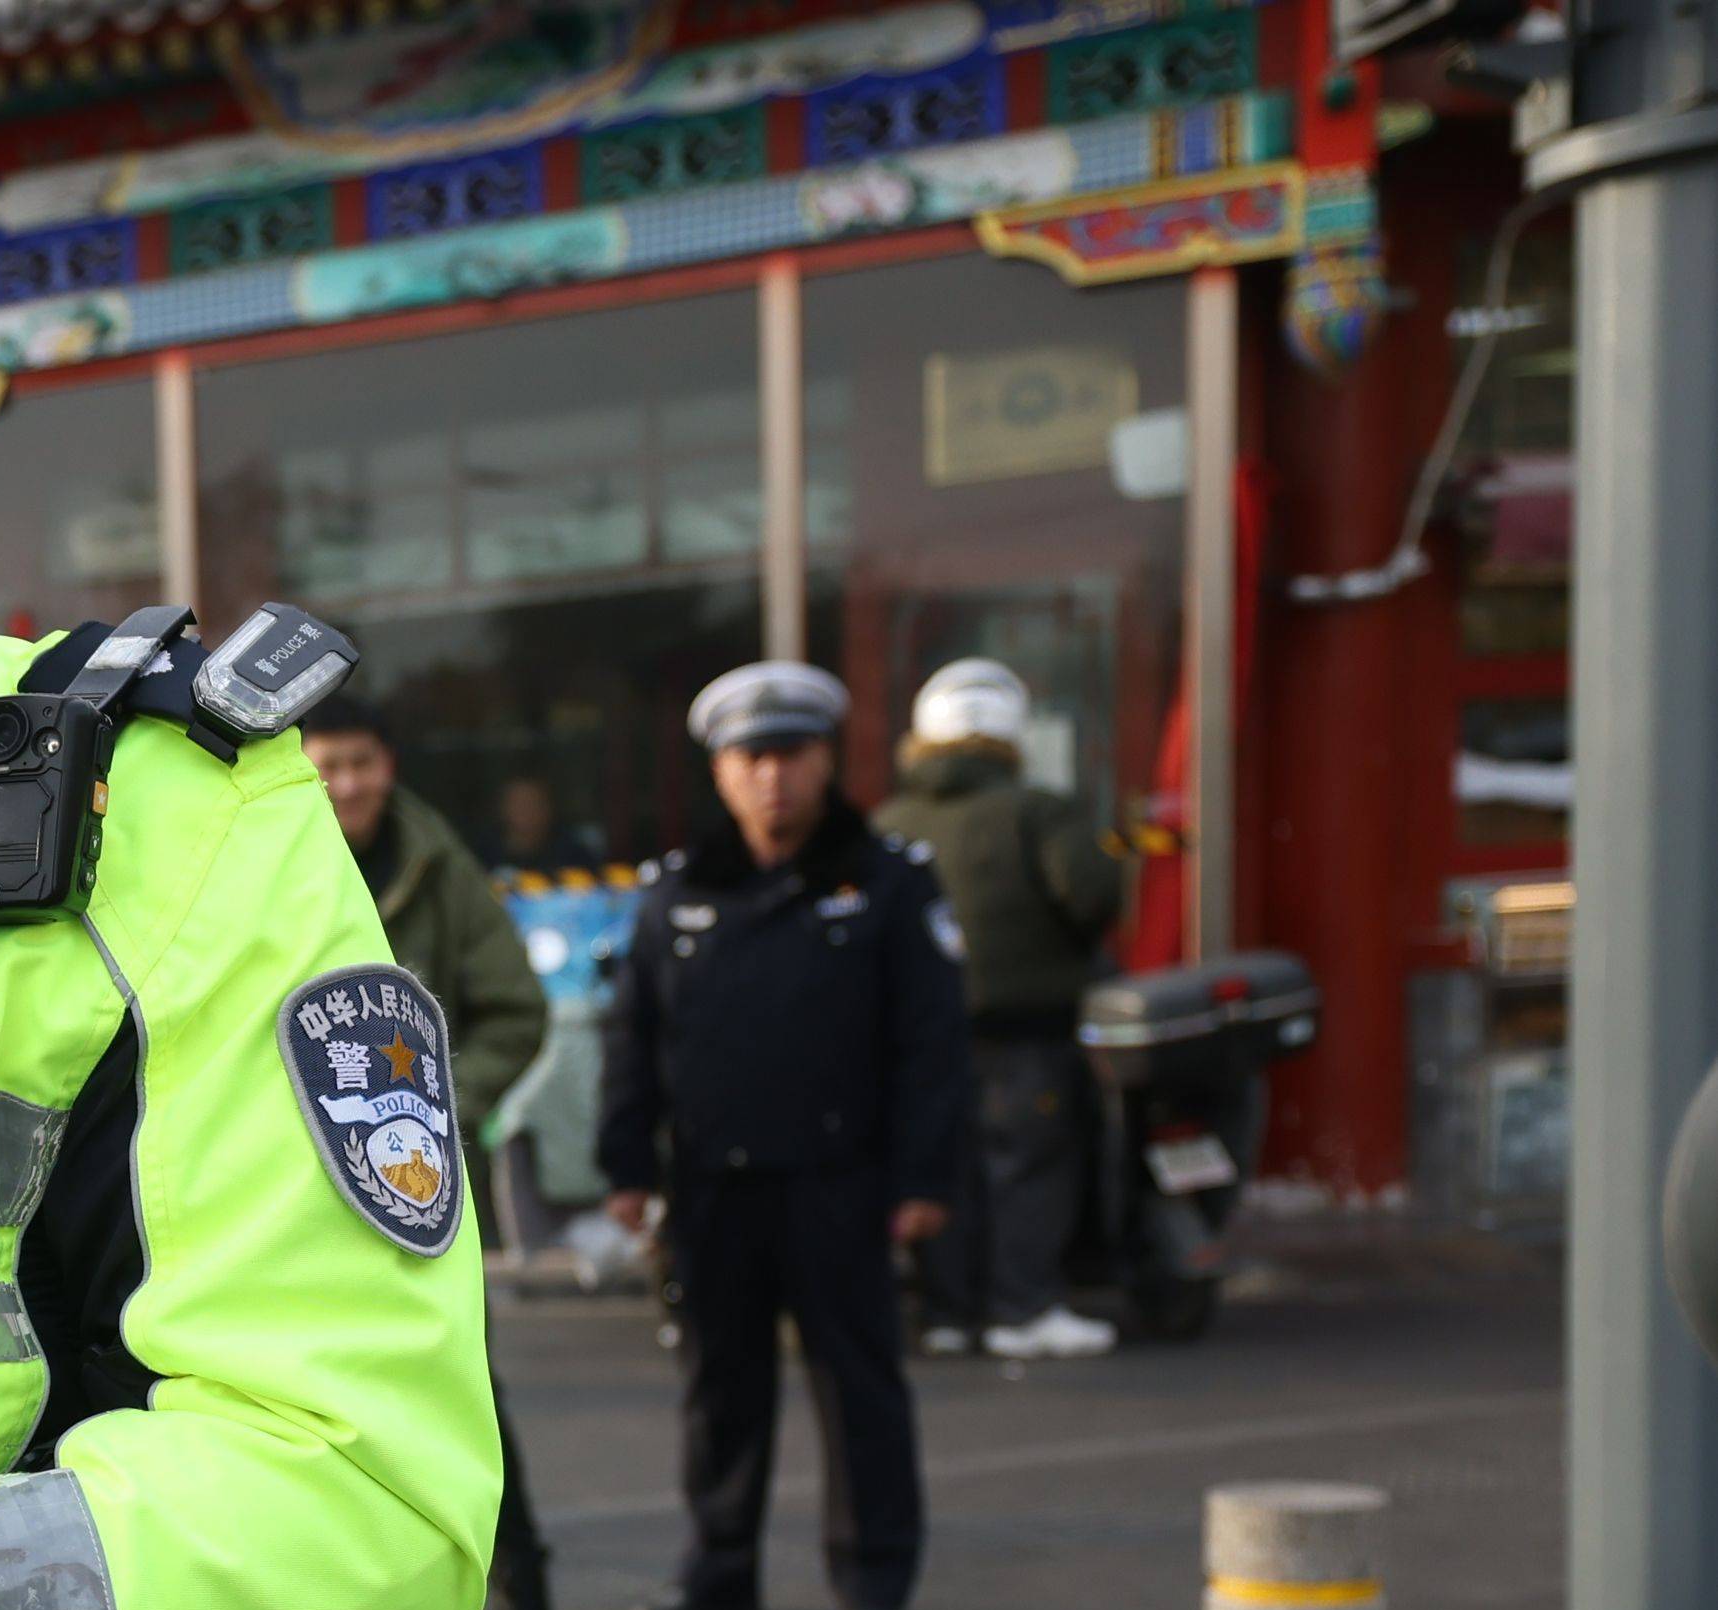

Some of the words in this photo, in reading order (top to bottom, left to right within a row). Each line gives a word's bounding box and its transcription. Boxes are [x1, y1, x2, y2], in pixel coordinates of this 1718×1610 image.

[255, 658, 280, 676] 警
[270, 634, 307, 664] POLICE
[299, 622, 323, 640] 察
[296, 984, 437, 1056] 中华人民共和国
[325, 1040, 371, 1090] 警
[421, 1053, 441, 1100] 察
[372, 1095, 432, 1125] POLICE
[387, 1131, 404, 1154] 公
[420, 1135, 433, 1158] 安
